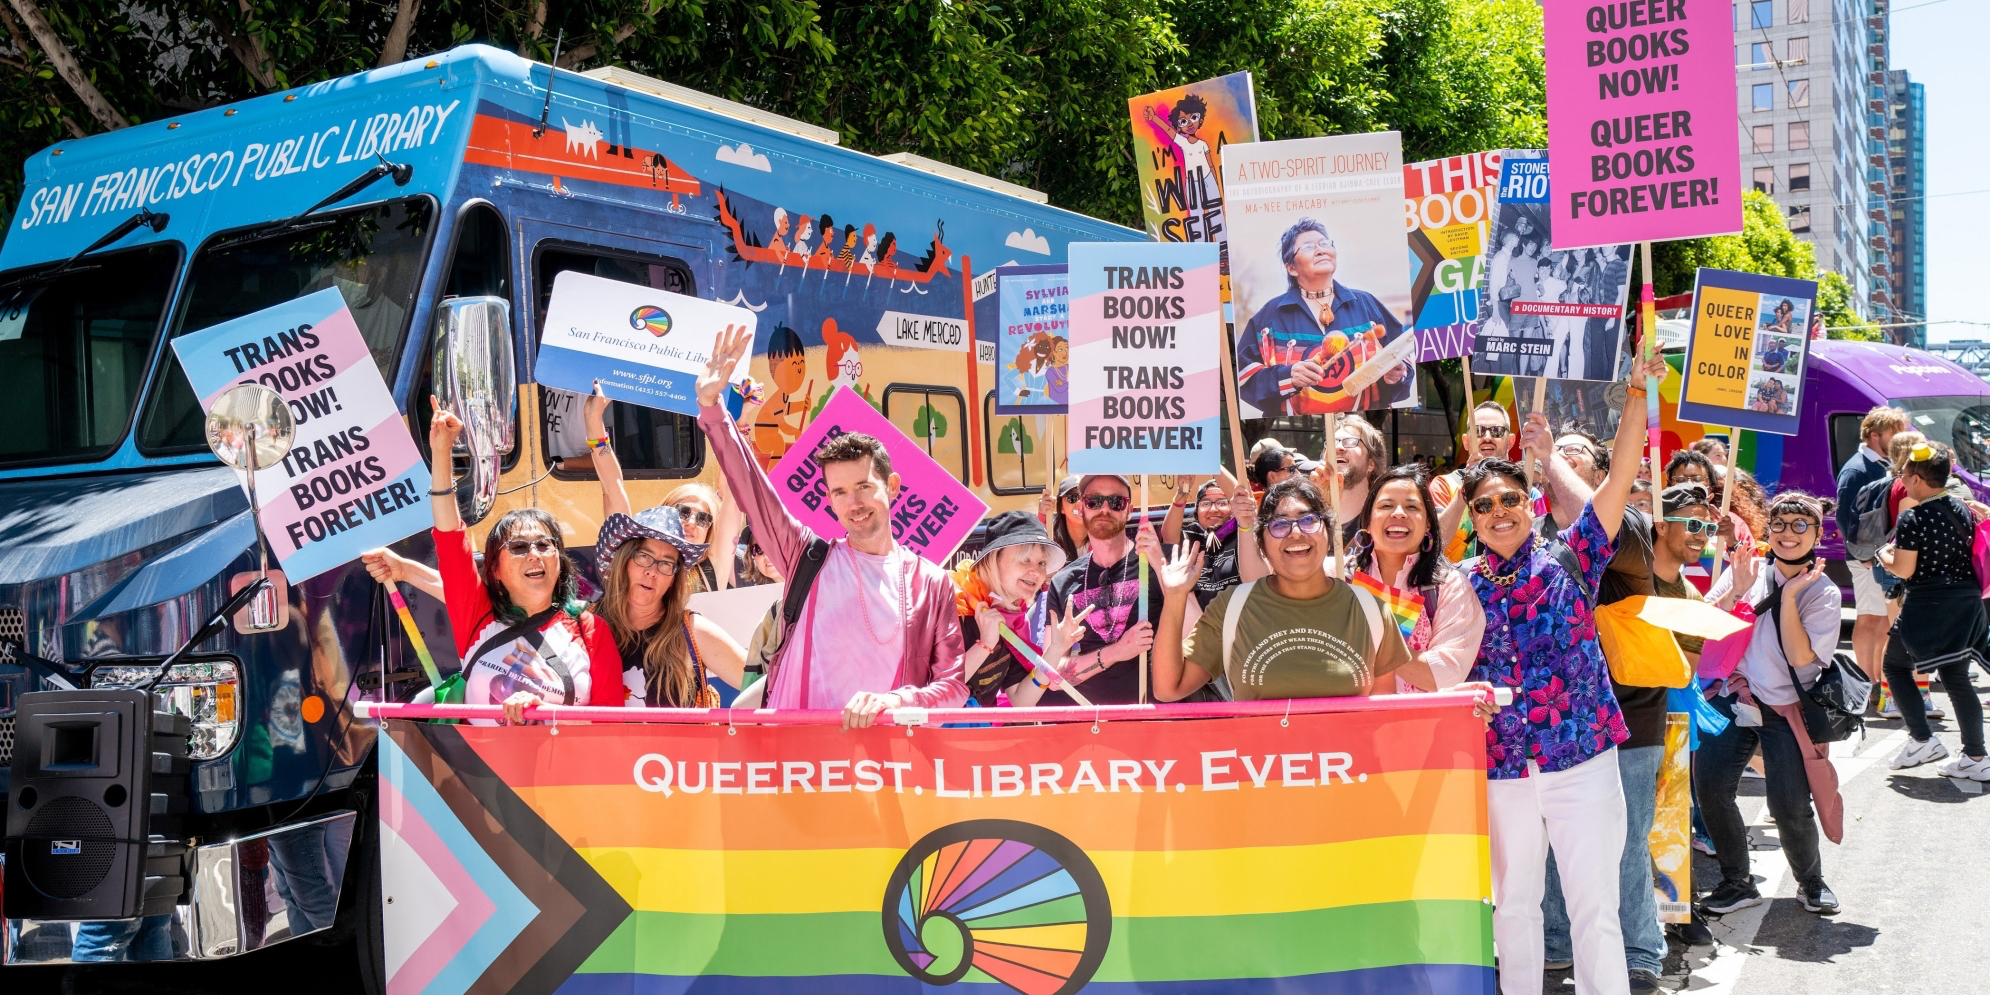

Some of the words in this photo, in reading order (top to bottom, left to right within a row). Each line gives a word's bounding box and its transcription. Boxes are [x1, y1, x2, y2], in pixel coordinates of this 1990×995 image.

[1586, 0, 1687, 33] QUEER
[1587, 28, 1690, 68] BOOKS
[1598, 63, 1679, 100] NOW!
[1590, 110, 1693, 148] QUEER
[21, 182, 84, 230] SAN
[80, 150, 234, 217] FRANCISCO
[232, 126, 340, 187] PUBLIC
[336, 99, 461, 164] LIBRARY
[1152, 144, 1178, 170] I'M
[1238, 163, 1248, 181] A
[1249, 156, 1327, 180] TWO-SPIRIT
[1330, 152, 1390, 175] JOURNEY
[1591, 144, 1695, 183] BOOKS
[1242, 184, 1292, 196] AUTOBIOGRAPHY
[1295, 183, 1302, 192] OF
[1311, 180, 1337, 191] LESBIAN
[1383, 176, 1402, 185] ELDER
[1411, 150, 1501, 196] THIS
[1500, 186, 1508, 198] the
[1508, 174, 1550, 199] RIO
[1570, 177, 1719, 220] FOREVER!
[1245, 201, 1282, 214] MA-NEE
[1285, 198, 1328, 211] CHACABY
[1162, 209, 1223, 242] SEE
[1440, 226, 1475, 234] INTRODUCTION
[975, 273, 996, 298] HUNTE
[1103, 266, 1185, 290] TRANS
[1434, 254, 1485, 294] GA
[1026, 286, 1069, 300] SYLVIA
[1023, 304, 1069, 316] MARSH
[1103, 296, 1186, 320] BOOKS
[1451, 288, 1480, 326] JU
[1521, 304, 1581, 314] DOCUMENTARY
[1583, 306, 1618, 315] HISTORY
[1706, 302, 1754, 321] QUEER
[896, 317, 919, 341] LAKE
[1112, 325, 1176, 349] NOW!
[1714, 323, 1752, 341] LOVE
[224, 323, 320, 374] TRANS
[568, 327, 590, 340] San
[592, 331, 646, 351] Francisco
[649, 343, 684, 359] Public
[685, 351, 709, 364] Libr
[1486, 341, 1517, 353] MARC
[1520, 343, 1551, 355] STEIN
[1734, 346, 1749, 361] IN
[612, 368, 673, 389] www.sfpl.org
[1103, 366, 1185, 390] TRANS
[1698, 361, 1746, 381] COLOR
[594, 377, 634, 391] nformation
[635, 385, 654, 395] (415)
[655, 389, 687, 401] 557-4400
[291, 386, 343, 426] OW!
[1103, 396, 1186, 420] BOOKS
[1085, 426, 1203, 450] FOREVER!
[281, 425, 370, 478] TRANS
[290, 455, 386, 511] BOOKS
[286, 478, 421, 550] FOREVER!
[891, 494, 927, 540] OKS
[1243, 649, 1257, 668] THEM
[1255, 638, 1269, 651] AND
[1267, 629, 1288, 641] THEY
[1307, 628, 1348, 647] EVERYONE
[1346, 645, 1355, 653] IN
[1354, 652, 1371, 686] BETWEEN
[1256, 646, 1273, 662] LOVERS
[1272, 639, 1288, 649] THAT
[1306, 637, 1325, 645] THEIR
[1325, 642, 1348, 657] COLORS
[1347, 655, 1360, 670] WITH
[1358, 669, 1366, 687] PRIDE
[1260, 663, 1268, 674] THE
[1265, 650, 1282, 665] REBELS
[1281, 645, 1296, 653] THAT
[1325, 650, 1338, 660] AND
[1338, 658, 1354, 674] NEVER
[632, 753, 924, 799] QUEEREST.
[932, 757, 1187, 800] LIBRARY.
[1199, 748, 1369, 793] EVER.
